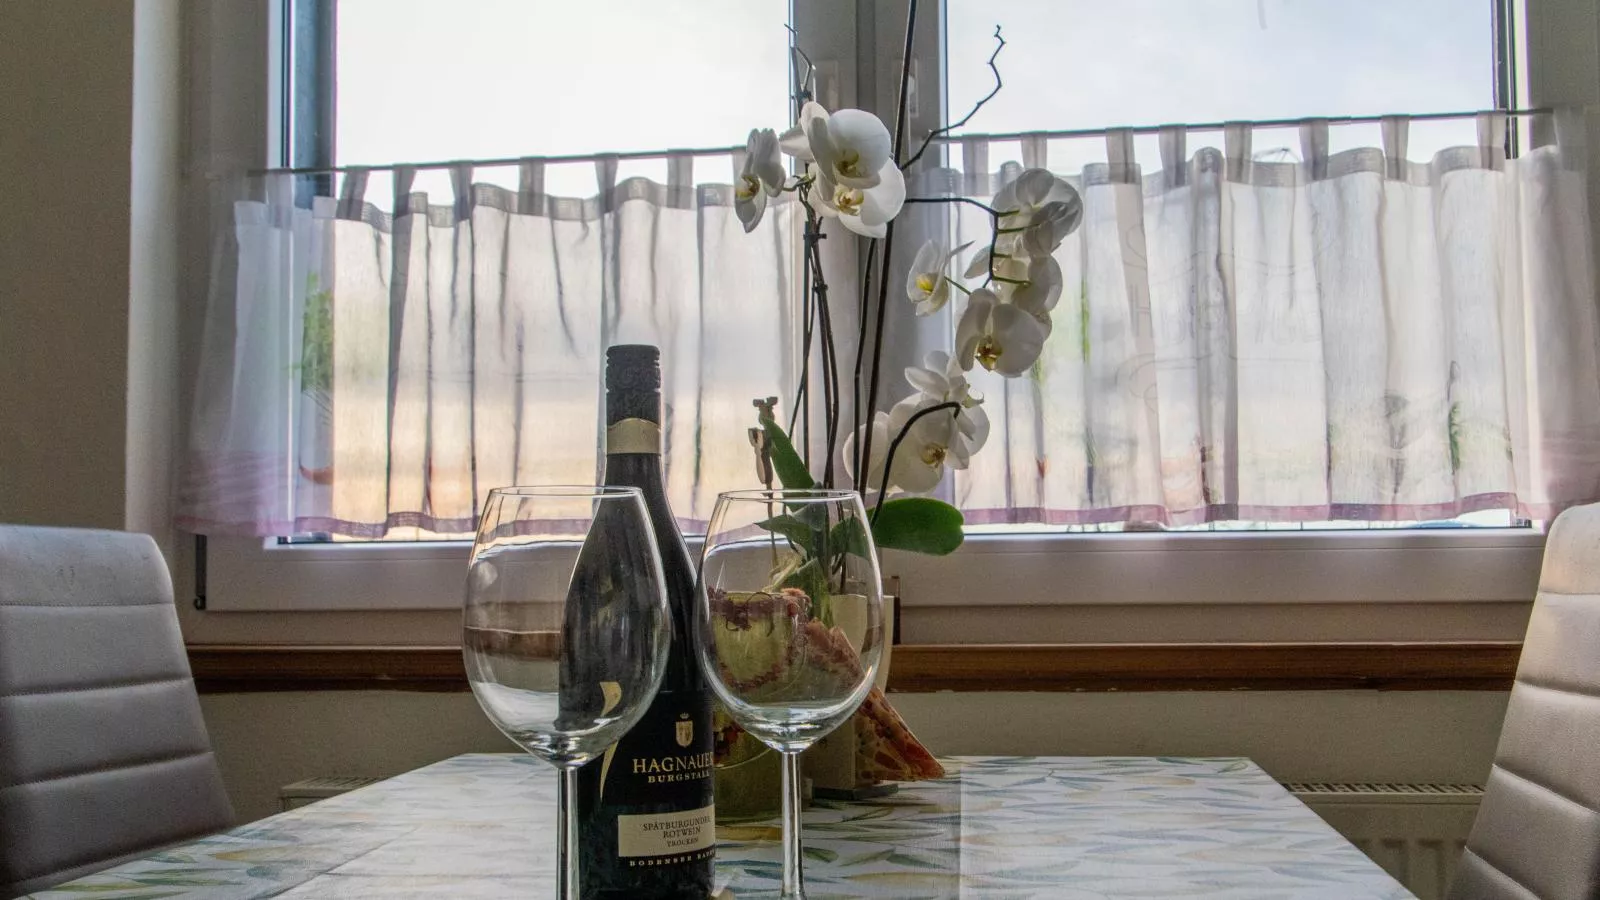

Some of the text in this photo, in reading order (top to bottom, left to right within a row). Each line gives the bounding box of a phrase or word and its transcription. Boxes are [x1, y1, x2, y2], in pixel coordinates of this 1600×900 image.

[663, 826, 701, 839] ROTWEIN
[667, 837, 699, 847] TROCKEN
[629, 855, 692, 867] BODENSEE
